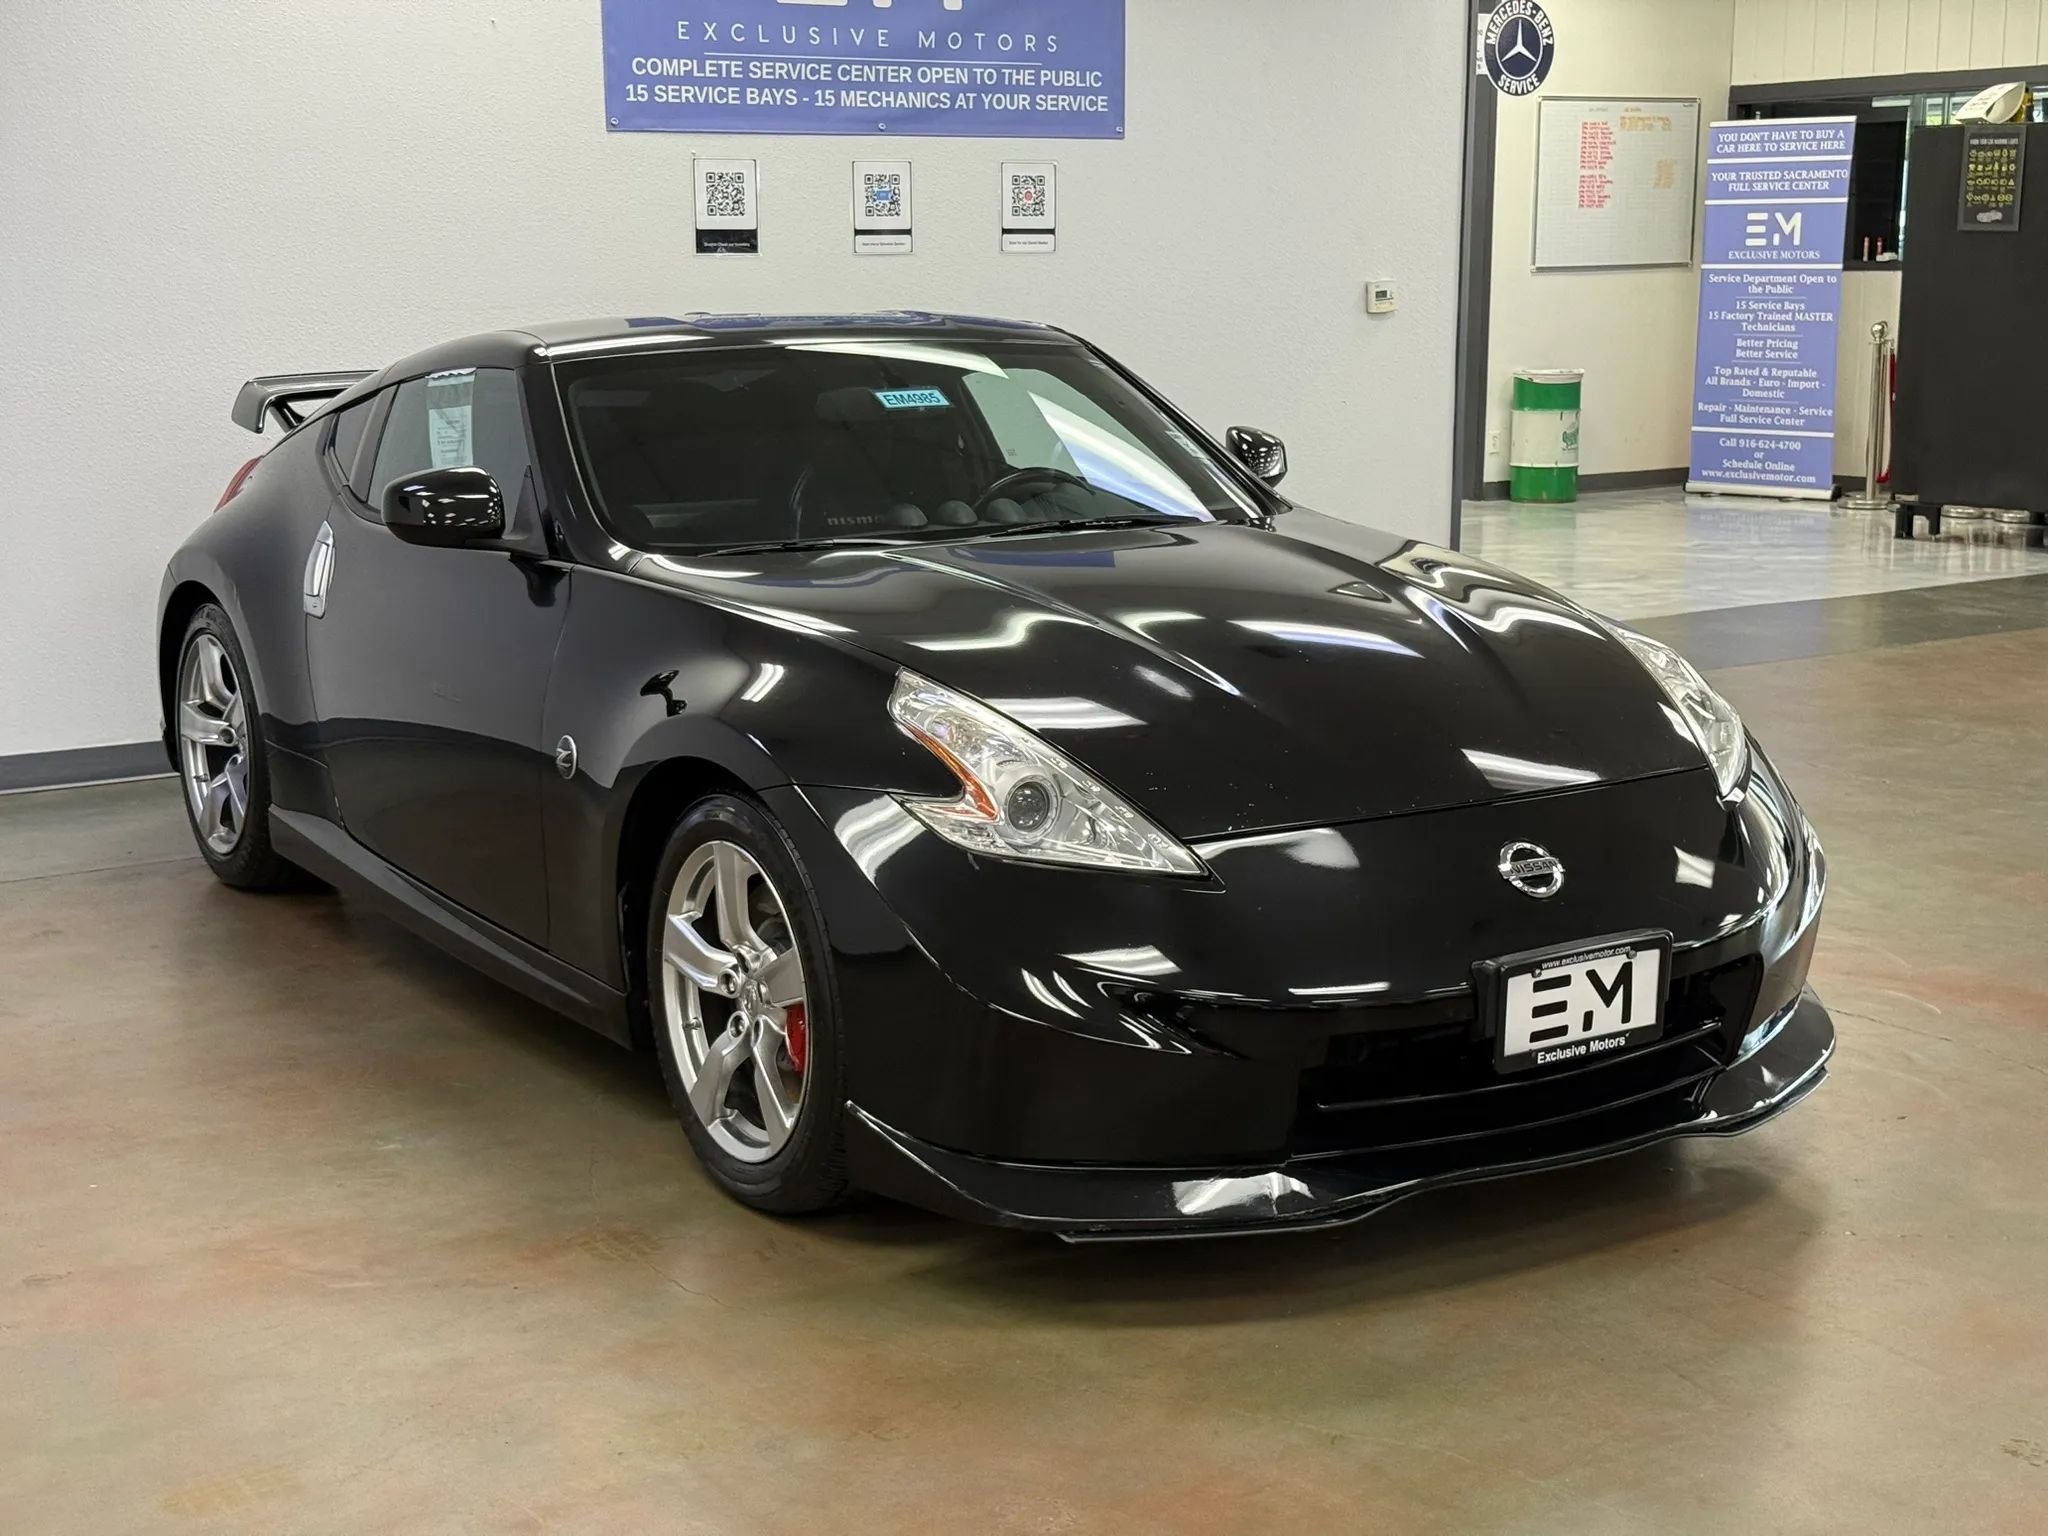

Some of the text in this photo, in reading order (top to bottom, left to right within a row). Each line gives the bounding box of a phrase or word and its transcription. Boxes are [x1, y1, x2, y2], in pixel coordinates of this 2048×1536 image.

[677, 20, 1057, 52] EXCLUSIVE MOTORS
[632, 57, 1103, 87] COMPLETE SERVICE CENTER OPEN TO THE PUBLIC
[1498, 73, 1540, 94] SERVICE
[625, 84, 649, 102] 15
[654, 85, 740, 104] SERVICE
[746, 88, 798, 105] BAYS
[814, 89, 835, 107] 15
[840, 91, 951, 109] MECHANICS
[955, 93, 977, 109] AT
[981, 93, 1031, 110] YOUR
[1035, 95, 1109, 112] SERVICE
[1719, 130, 1845, 142] YOU DON'T HAVE TO BUY A
[1716, 140, 1845, 153] CAR HERE TO SERVICE HERE
[1712, 169, 1848, 181] YOUR TRUSTED SACRAMENTO
[1728, 181, 1829, 192] FULL SERVICE CENTER
[1745, 212, 1802, 246] EM
[1728, 250, 1820, 260] EXCLUSIVE MOTORS
[1709, 274, 1837, 284] Service Department Open to
[1748, 284, 1794, 294] the Public
[1736, 301, 1805, 312] 15 Service Bays
[1709, 311, 1833, 322] 15 Factory Trained MASTER
[1741, 322, 1796, 332] Technicians
[1736, 338, 1798, 350] Better Pricing
[1735, 349, 1798, 359] Better Service
[1714, 366, 1817, 378] Top Rated & Reputable
[1705, 376, 1718, 385] All
[1720, 376, 1751, 386] Brands
[1758, 378, 1780, 388] Euro
[1787, 379, 1820, 391] Import
[882, 393, 941, 406] EM4985
[1742, 388, 1785, 399] Domestic
[1698, 402, 1727, 413] Repair
[1734, 404, 1791, 414] Maintenance
[1799, 406, 1833, 417] Service
[1720, 414, 1806, 426] Full Service Center
[1719, 438, 1801, 451] Call 916-624-4700
[1753, 451, 1764, 459] or
[1722, 459, 1795, 472] Schedule Online
[1702, 469, 1816, 483] www.exclusivemotor.com
[1510, 861, 1558, 874] NISSAN
[1541, 946, 1631, 969] www.exclusivemotor.com
[1529, 961, 1633, 1044] EM
[1537, 1037, 1626, 1064] Exclusive Motors
